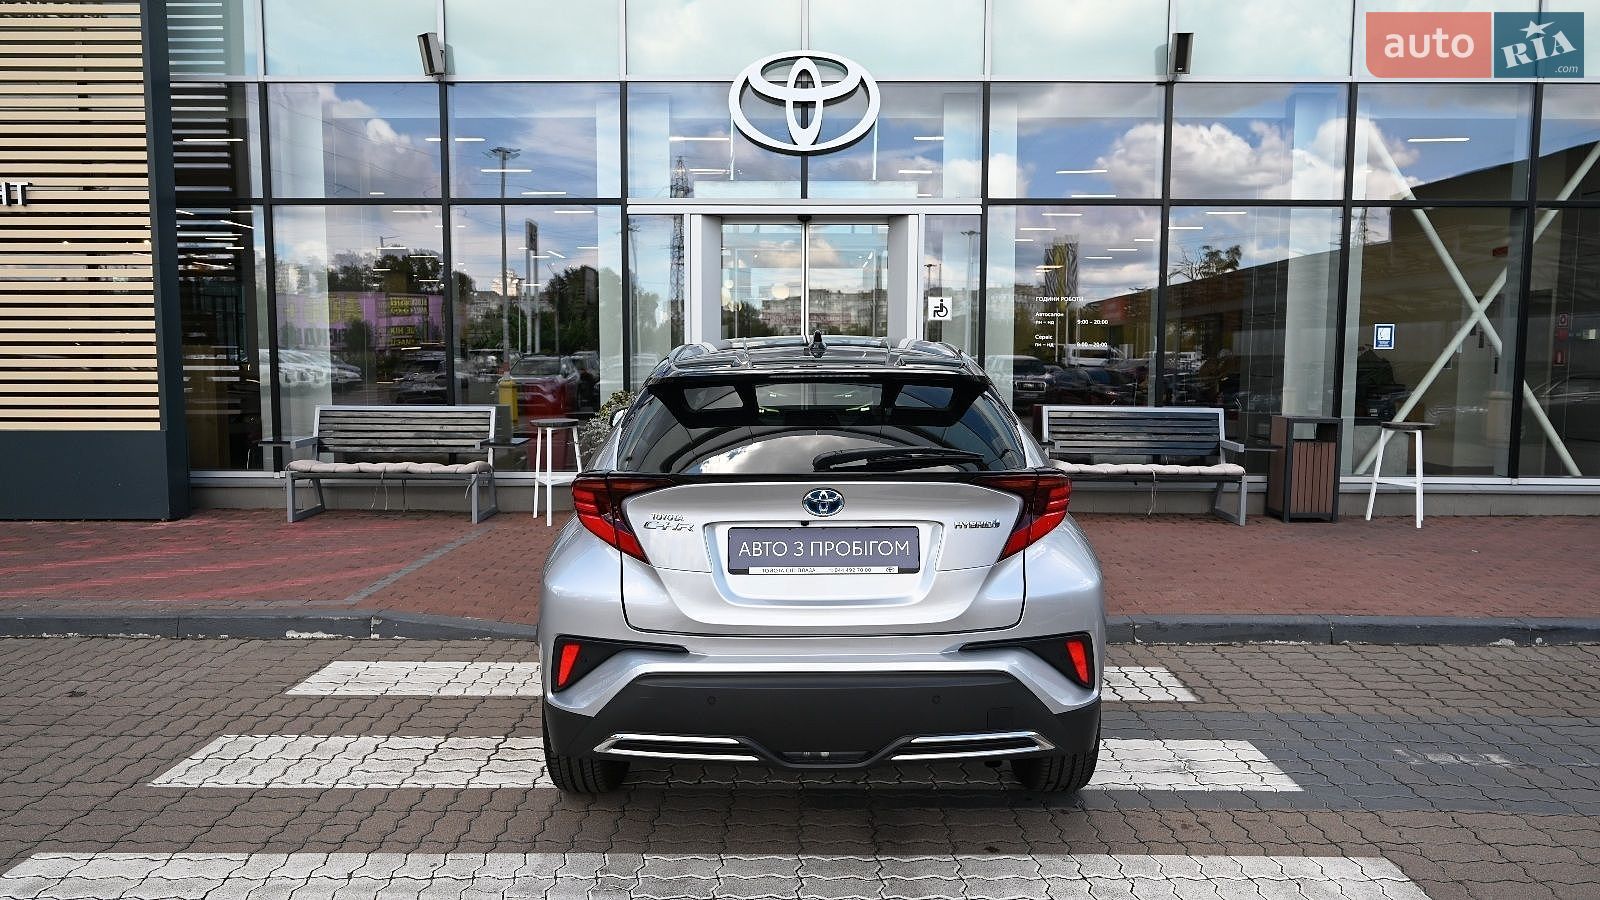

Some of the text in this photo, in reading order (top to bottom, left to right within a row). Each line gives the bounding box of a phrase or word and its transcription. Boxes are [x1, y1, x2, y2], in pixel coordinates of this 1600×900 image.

[738, 540, 911, 557] АВТО З ПРОБІГОМ
